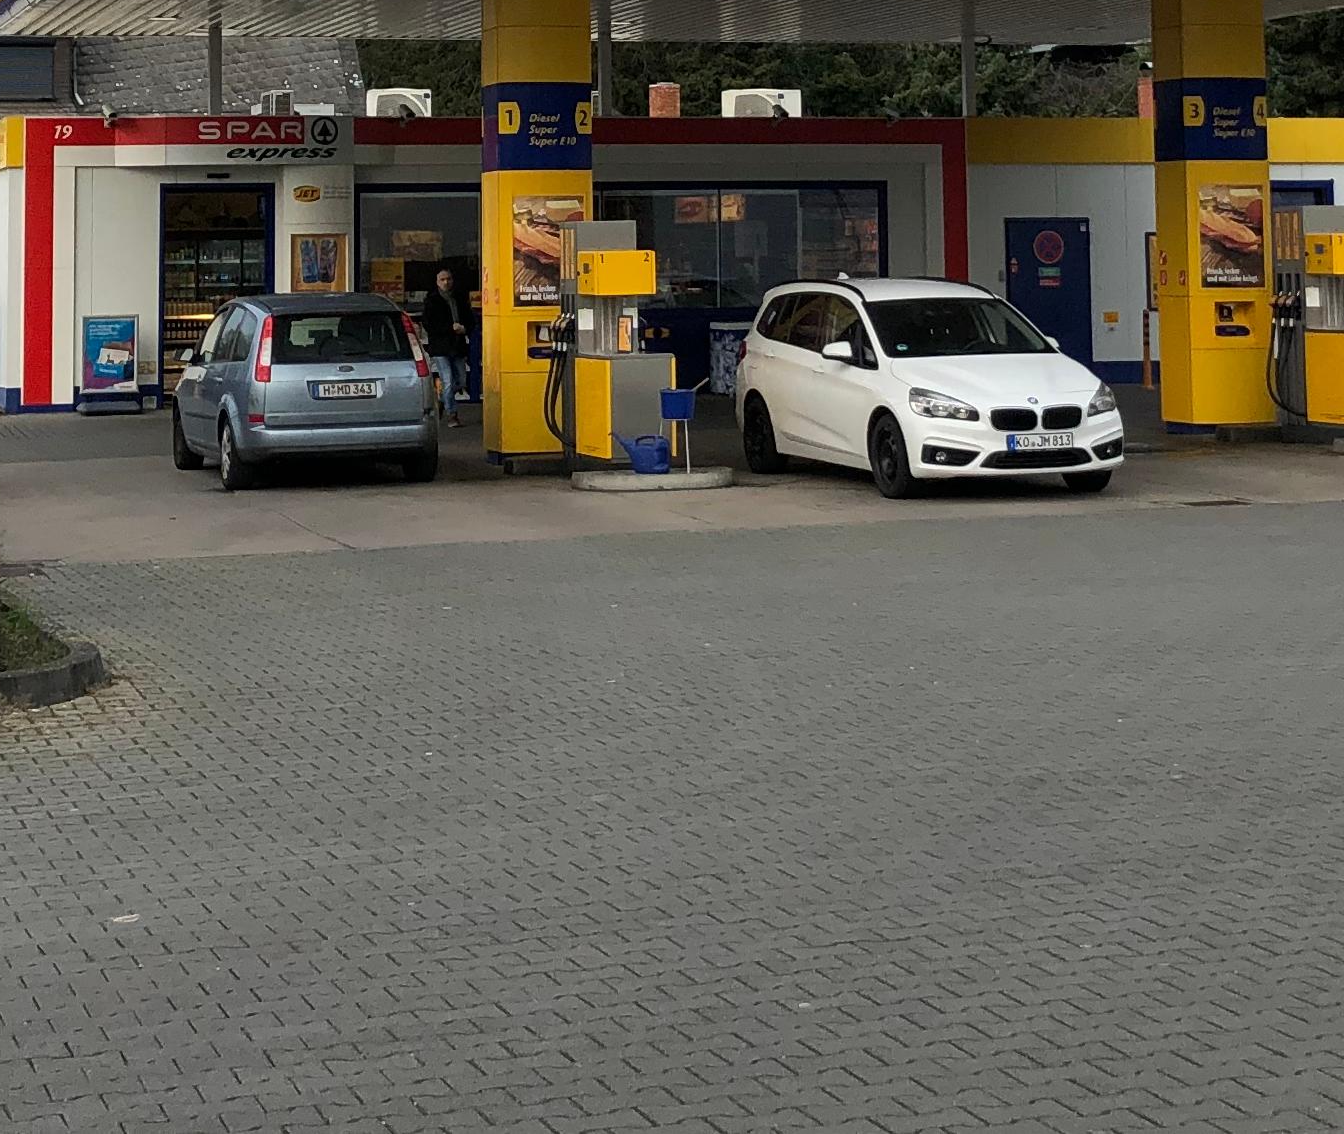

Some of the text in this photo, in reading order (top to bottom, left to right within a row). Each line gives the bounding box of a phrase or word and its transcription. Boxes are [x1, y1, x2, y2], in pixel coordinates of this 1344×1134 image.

[1189, 103, 1200, 118] 3
[1256, 103, 1265, 119] 4
[504, 109, 513, 126] 1
[529, 113, 560, 123] Diesel
[579, 109, 588, 127] 2
[53, 124, 73, 139] 19
[198, 121, 303, 140] SPAR
[528, 125, 558, 137] Super
[529, 136, 577, 148] Super E10
[226, 146, 337, 162] express
[599, 253, 605, 264] 1
[643, 252, 650, 262] 2
[352, 384, 373, 395] 343
[1052, 434, 1071, 446] 813
